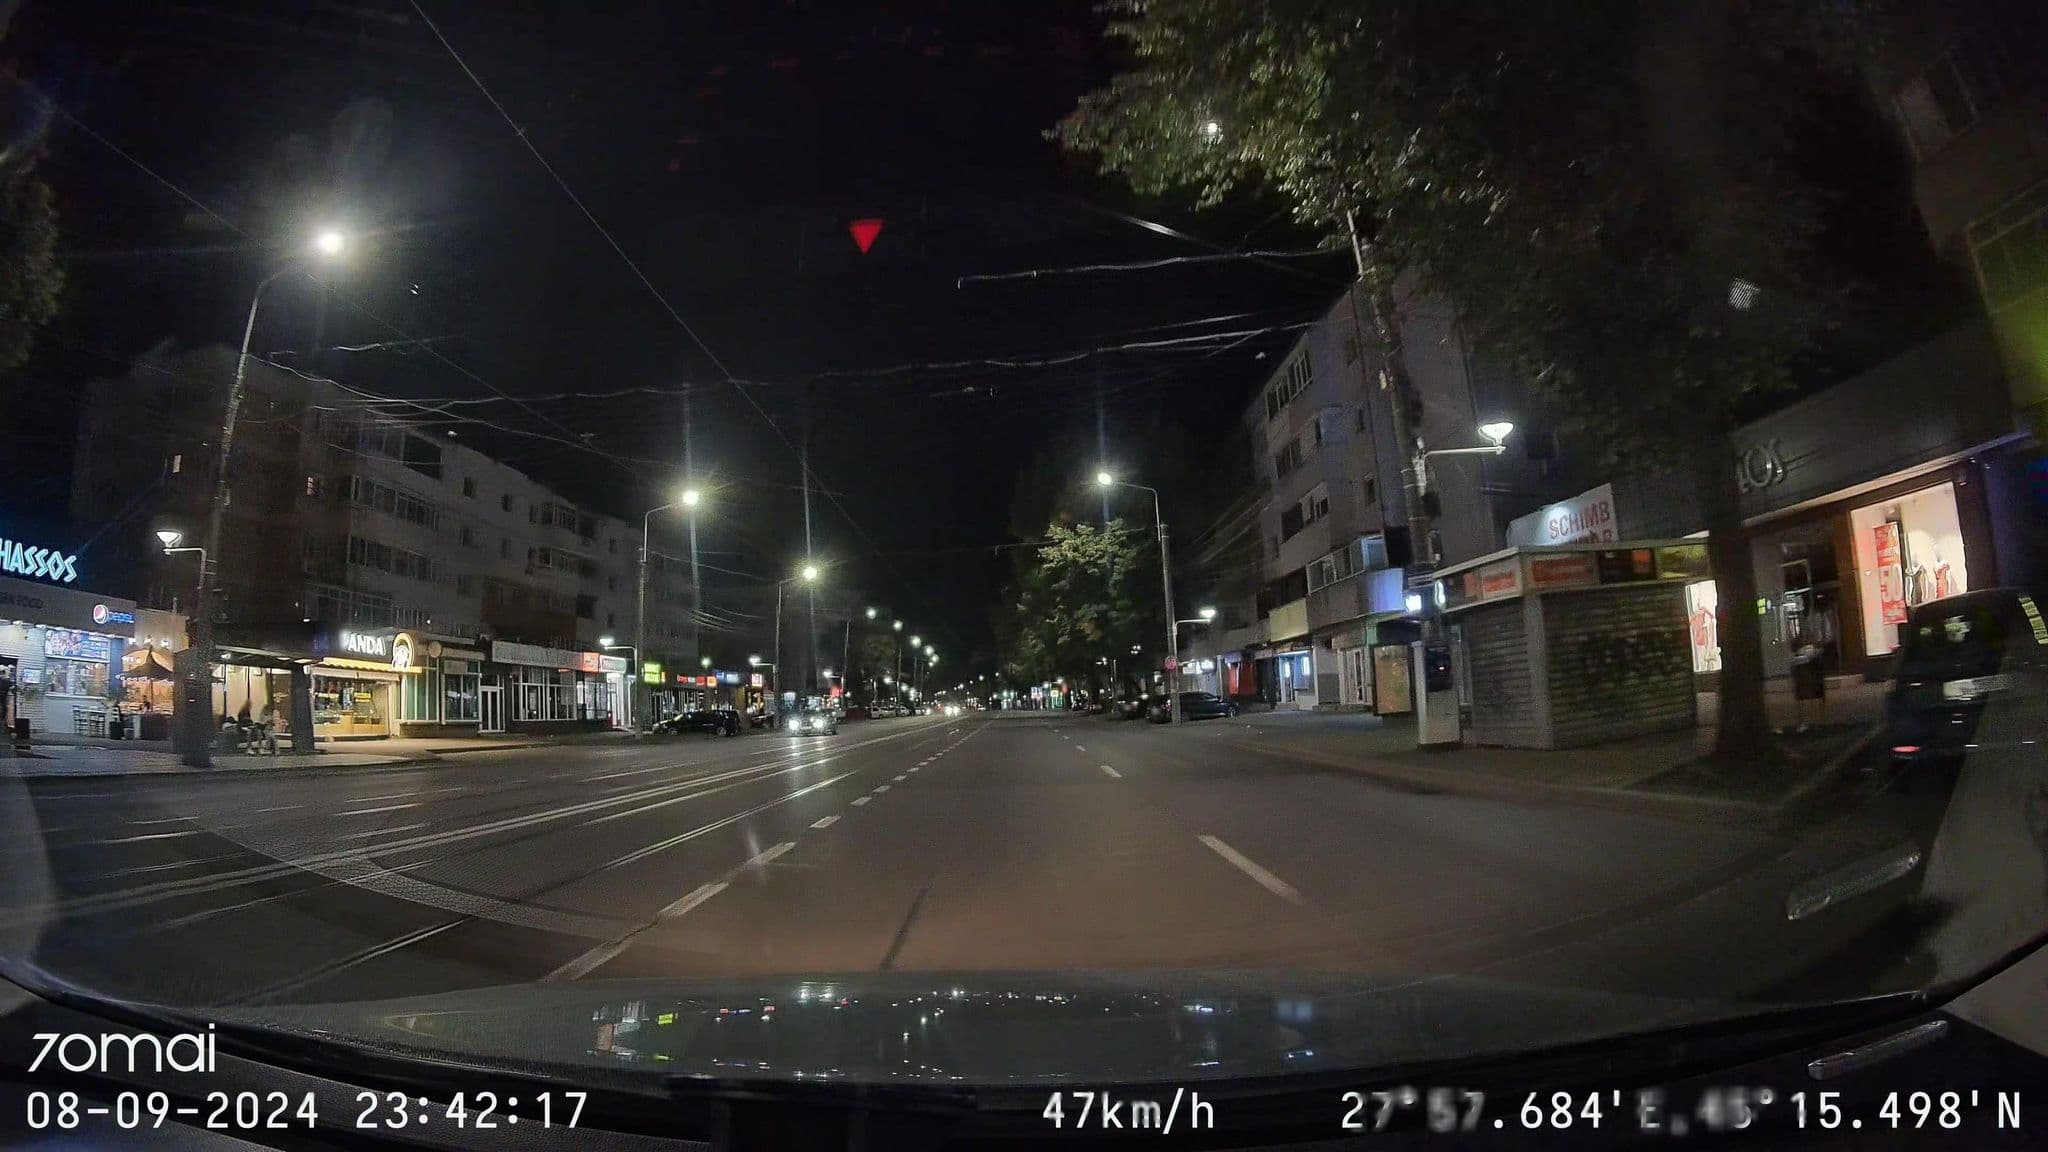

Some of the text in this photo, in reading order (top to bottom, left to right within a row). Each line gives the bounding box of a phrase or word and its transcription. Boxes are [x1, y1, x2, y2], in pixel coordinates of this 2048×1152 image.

[1549, 501, 1610, 539] SCHIMB
[0, 538, 78, 583] HASSOS
[340, 631, 387, 656] PANDA
